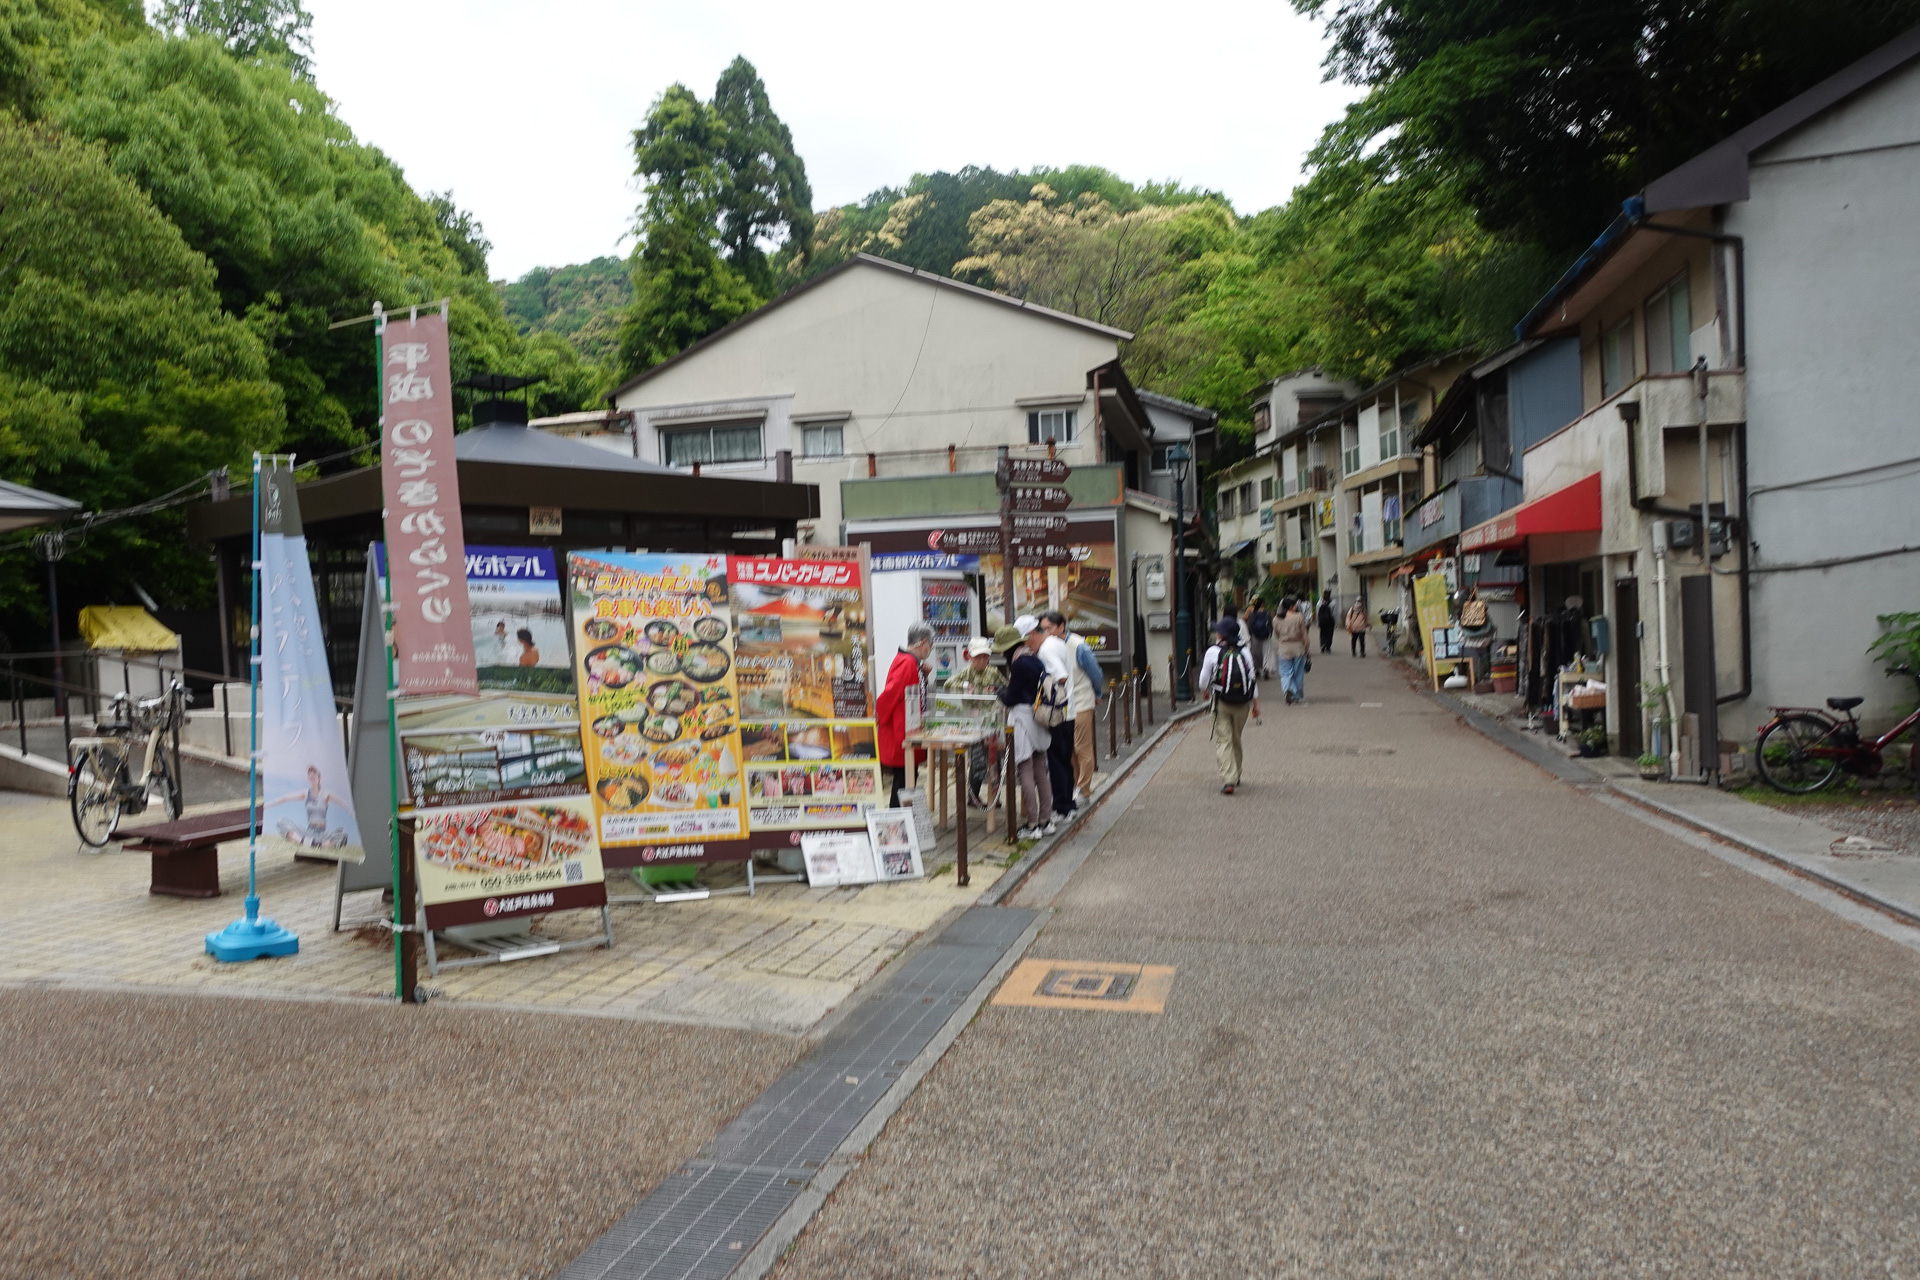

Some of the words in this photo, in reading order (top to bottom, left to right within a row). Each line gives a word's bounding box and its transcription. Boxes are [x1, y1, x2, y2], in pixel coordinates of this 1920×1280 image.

[754, 562, 851, 585] スパーガーデン
[594, 598, 713, 620] 食事も楽しい
